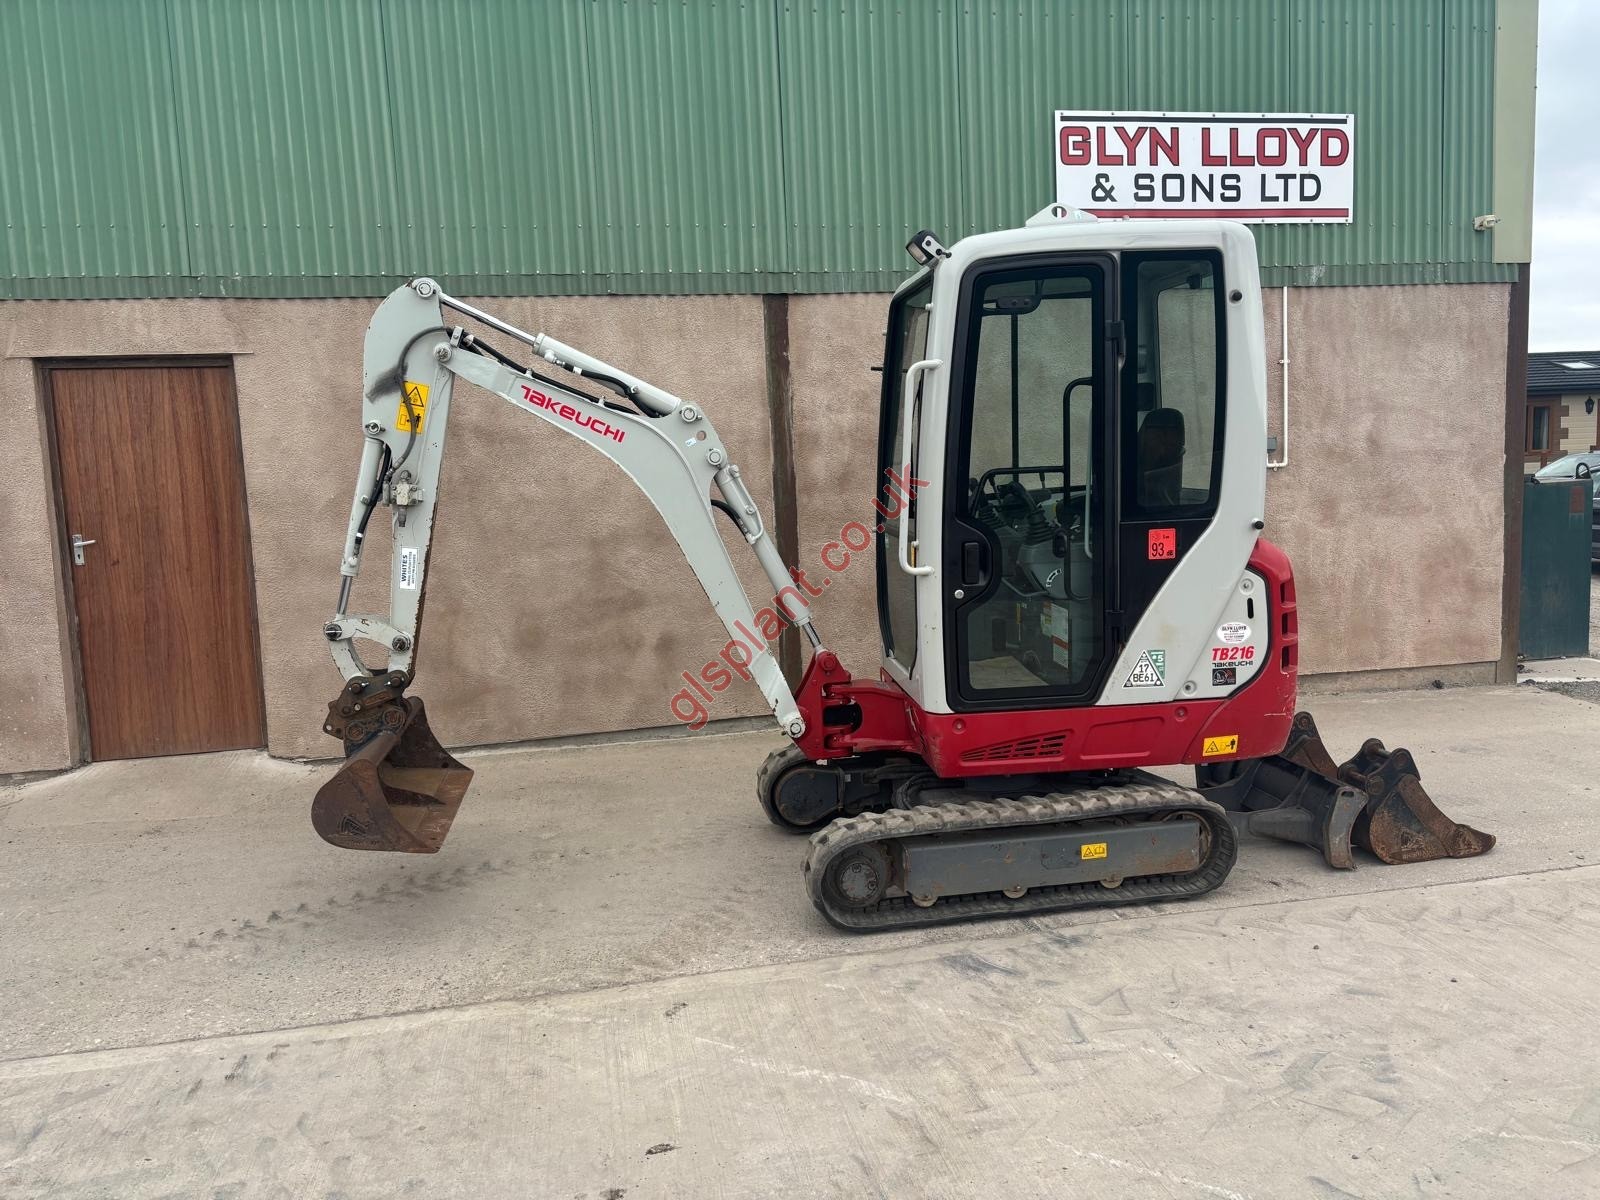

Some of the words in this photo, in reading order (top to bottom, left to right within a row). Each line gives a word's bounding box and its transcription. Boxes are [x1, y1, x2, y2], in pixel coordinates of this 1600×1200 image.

[1060, 126, 1179, 166] GLYN
[1201, 127, 1349, 167] LLOYD
[1091, 173, 1117, 202] &
[1133, 173, 1241, 202] SONS
[1260, 173, 1321, 202] LTD
[521, 384, 625, 443] TAKEUCHI
[1151, 543, 1164, 557] 93
[1212, 646, 1255, 661] TB216
[1139, 664, 1150, 673] 17
[1133, 673, 1154, 682] BE61
